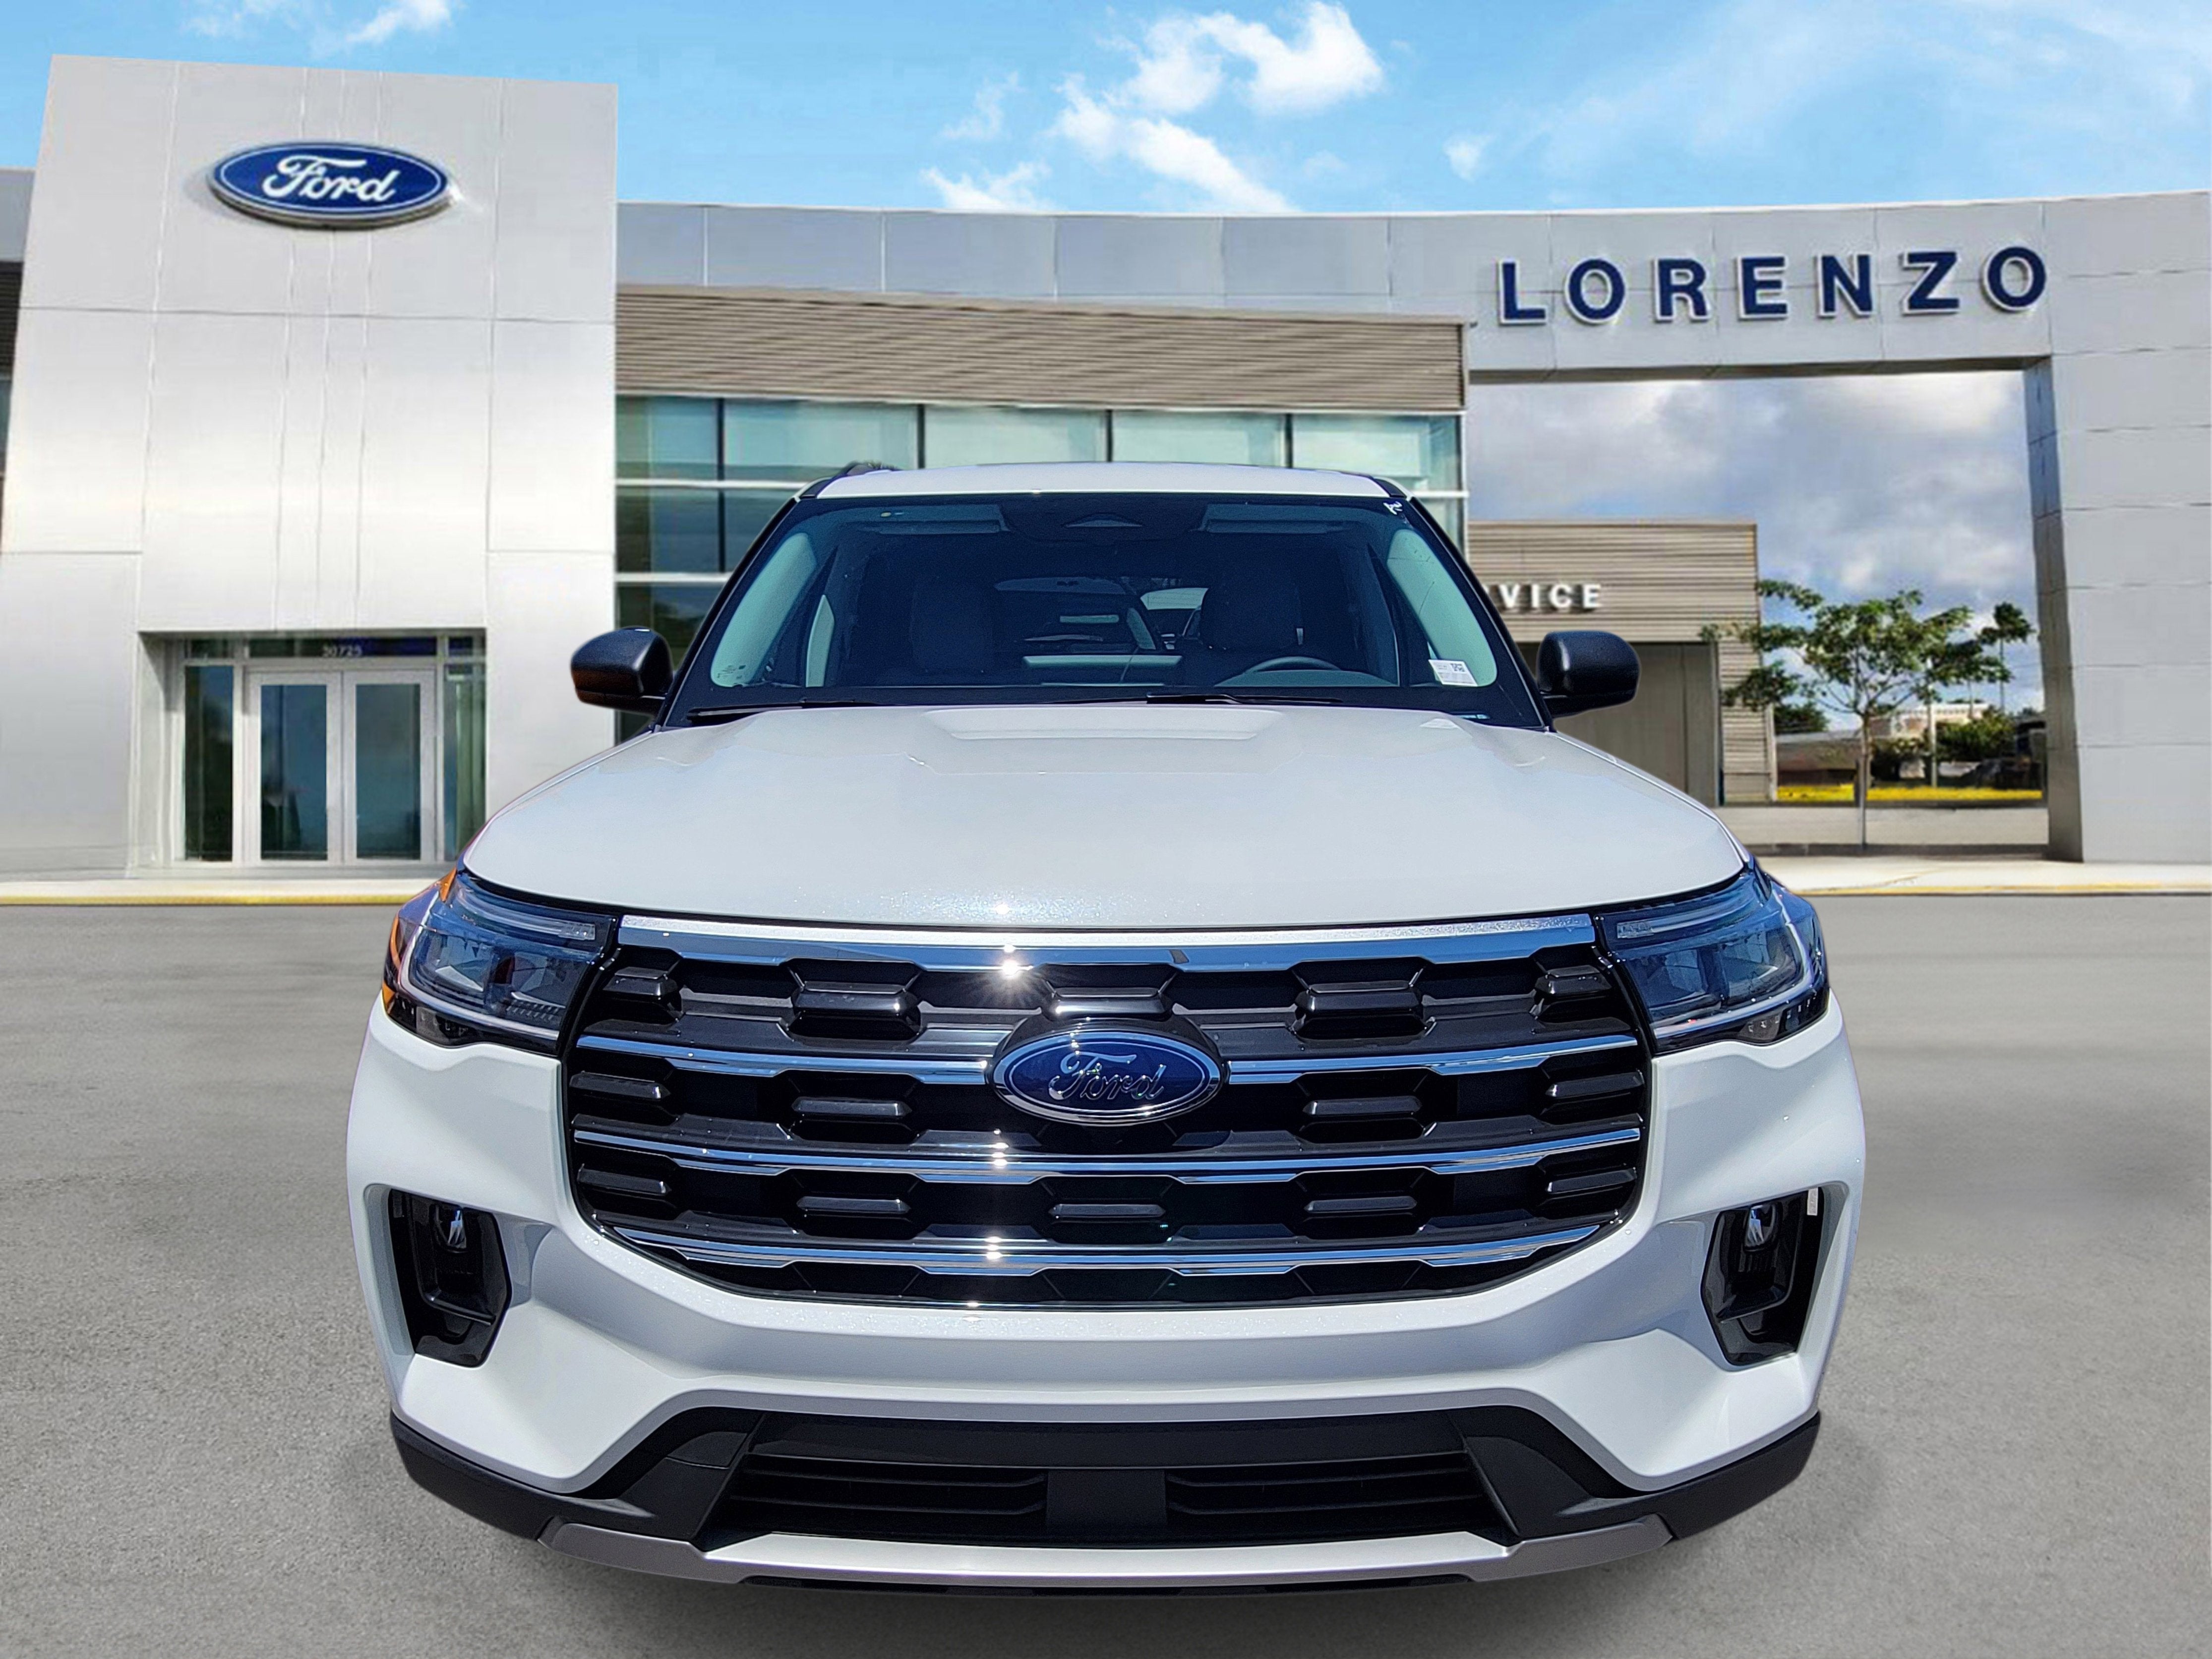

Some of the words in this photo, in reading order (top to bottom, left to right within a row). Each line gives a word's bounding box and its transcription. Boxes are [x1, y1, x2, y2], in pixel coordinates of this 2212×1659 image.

[262, 155, 401, 201] Ford
[1498, 246, 2047, 325] LORENZO
[1483, 585, 1602, 608] VICE
[1049, 1051, 1167, 1100] Ford
